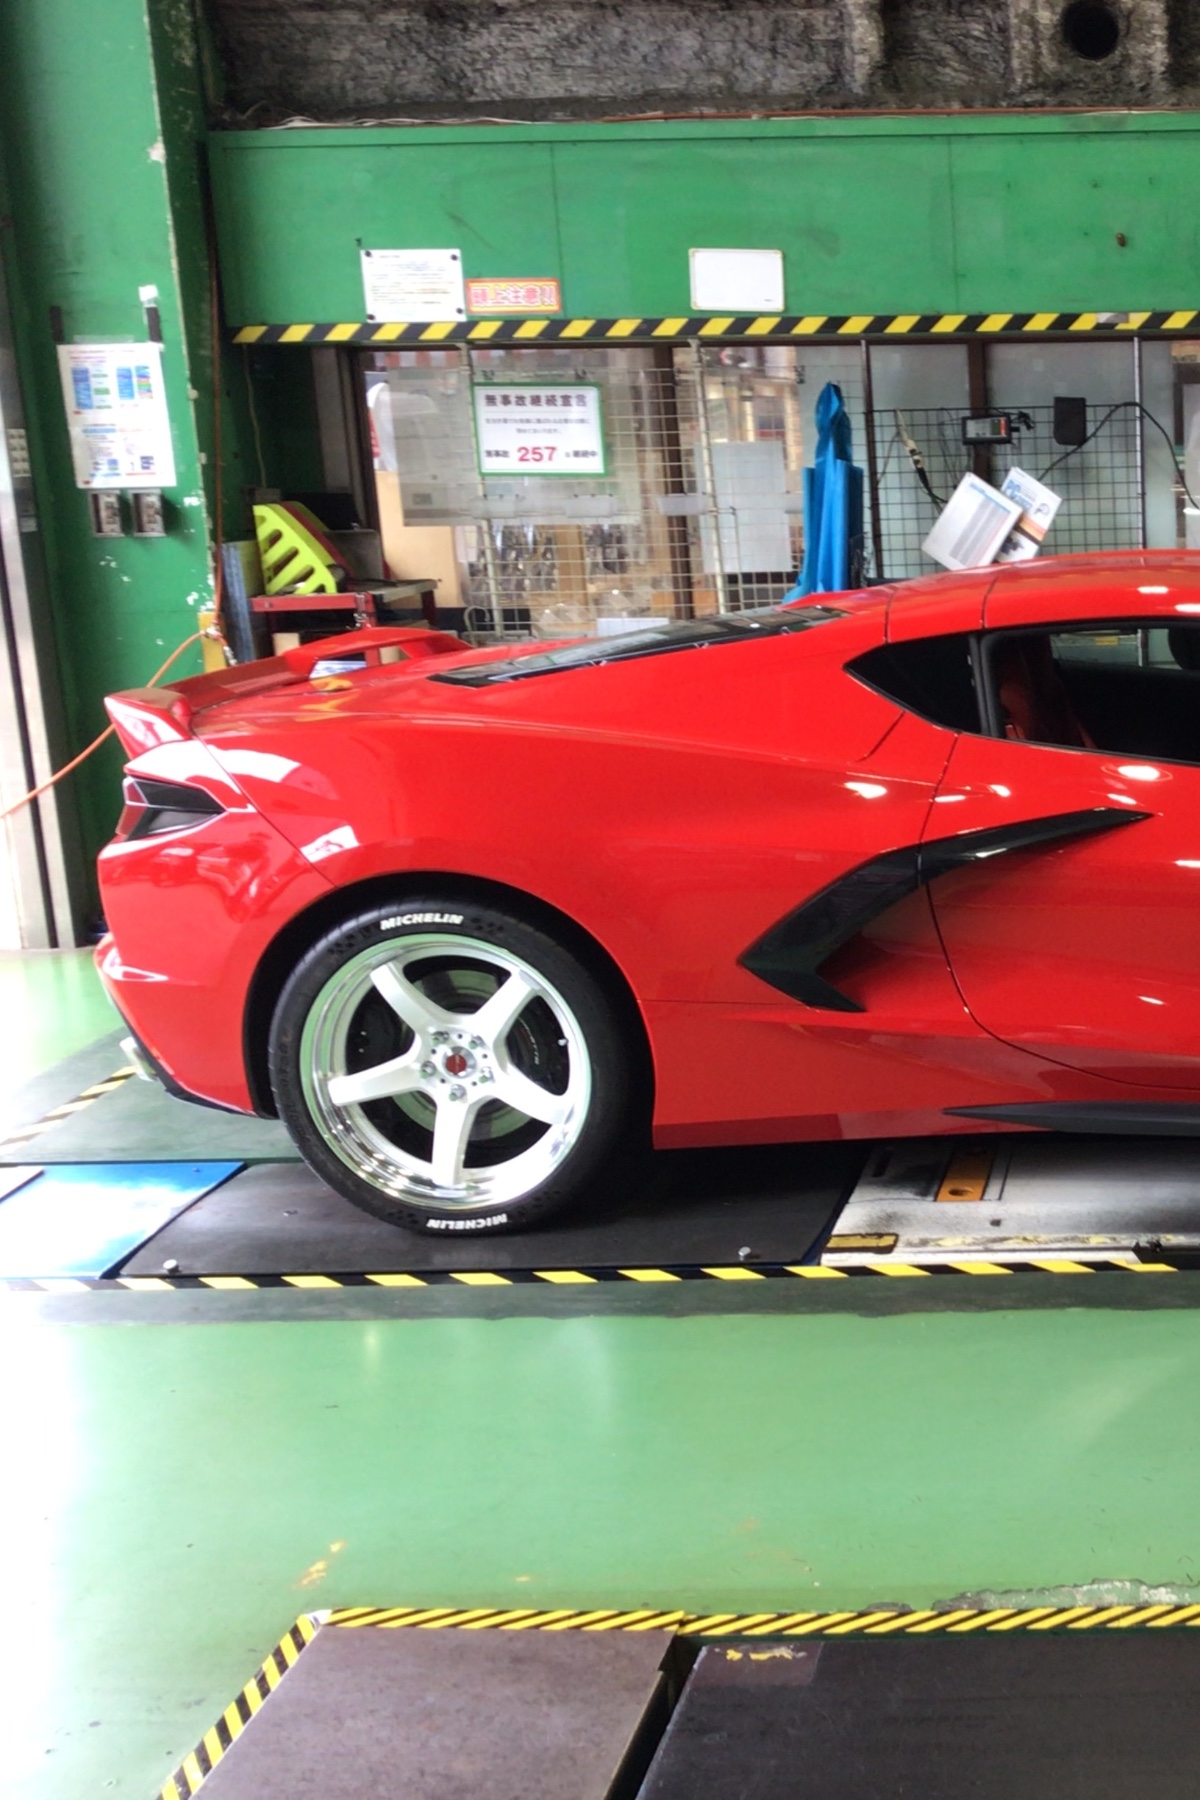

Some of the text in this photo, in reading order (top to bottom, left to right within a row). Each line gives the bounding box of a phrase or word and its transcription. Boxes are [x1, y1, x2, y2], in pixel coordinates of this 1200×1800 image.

[517, 446, 557, 462] 257
[380, 912, 464, 930] MICHELIN
[426, 1213, 507, 1230] MICHELIN
